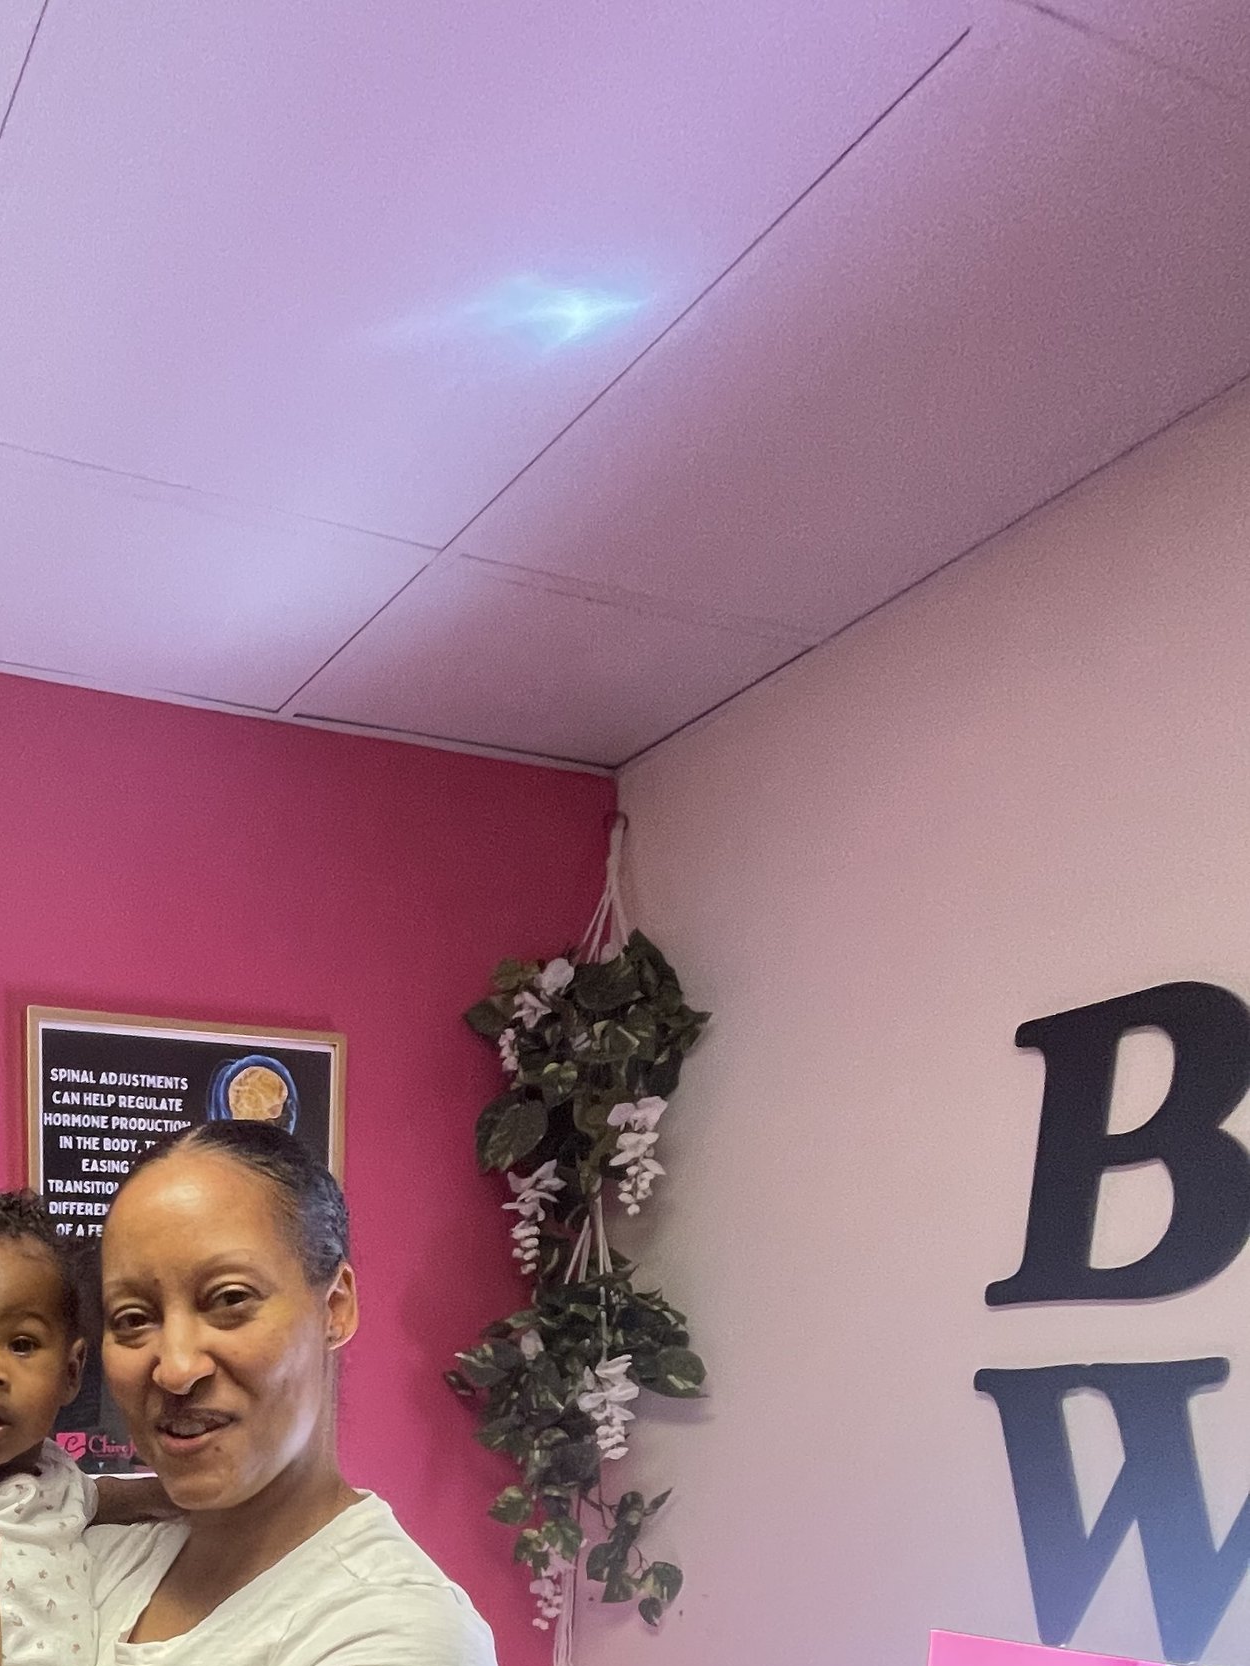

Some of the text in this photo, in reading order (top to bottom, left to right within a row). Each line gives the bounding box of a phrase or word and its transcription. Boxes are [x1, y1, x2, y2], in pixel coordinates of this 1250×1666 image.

[50, 1067, 189, 1091] SPINAL ADJUSTMENTS
[52, 1091, 184, 1112] CAN HELP REGULATE
[43, 1112, 109, 1129] HORMONE
[59, 1135, 73, 1149] IN
[76, 1136, 100, 1151] THE
[986, 982, 1250, 1307] B
[81, 1158, 130, 1174] EASING
[48, 1201, 110, 1216] DIFFEREN
[55, 1223, 73, 1236] OF
[75, 1224, 85, 1237] A
